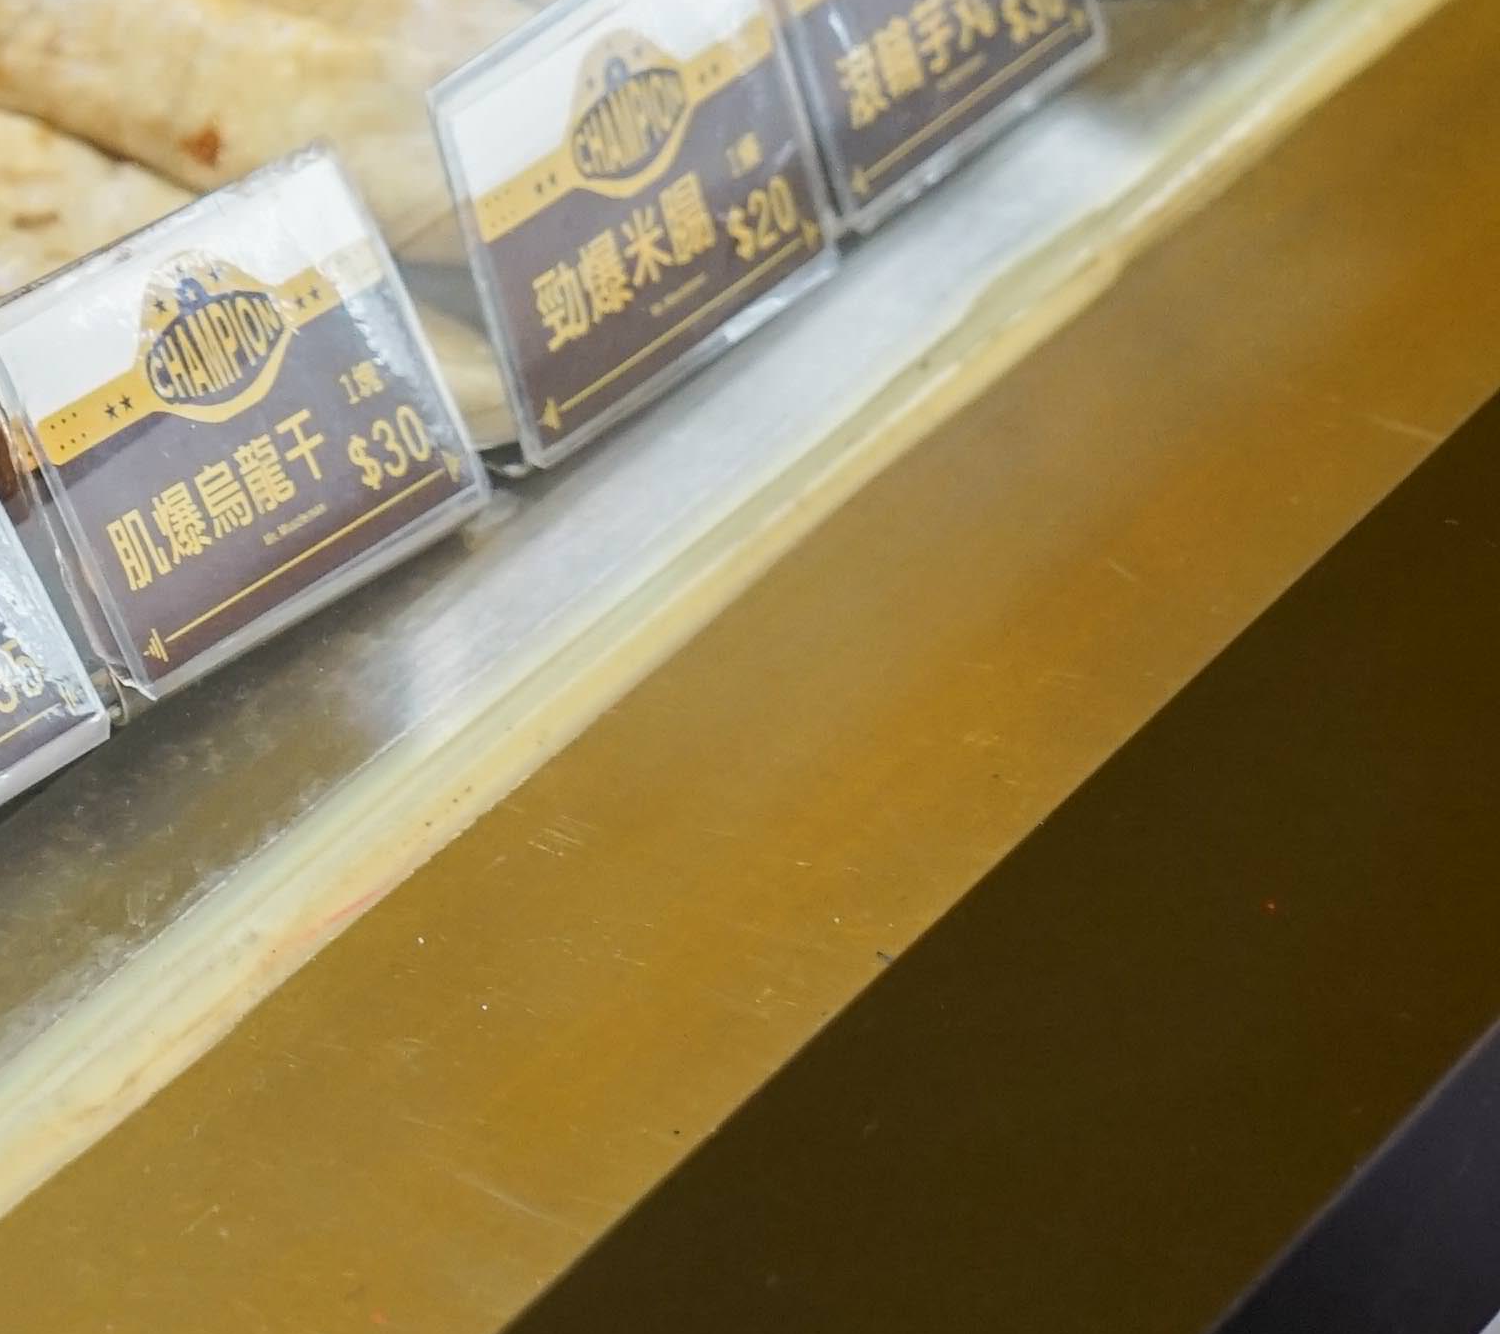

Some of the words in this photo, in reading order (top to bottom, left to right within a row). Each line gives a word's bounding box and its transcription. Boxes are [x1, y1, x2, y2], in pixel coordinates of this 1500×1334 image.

[576, 72, 687, 178] CHAMPION
[728, 178, 796, 261] $20
[146, 292, 280, 404] CHAMPION
[107, 409, 326, 590] 肌爆烏龍干
[347, 405, 432, 490] $30
